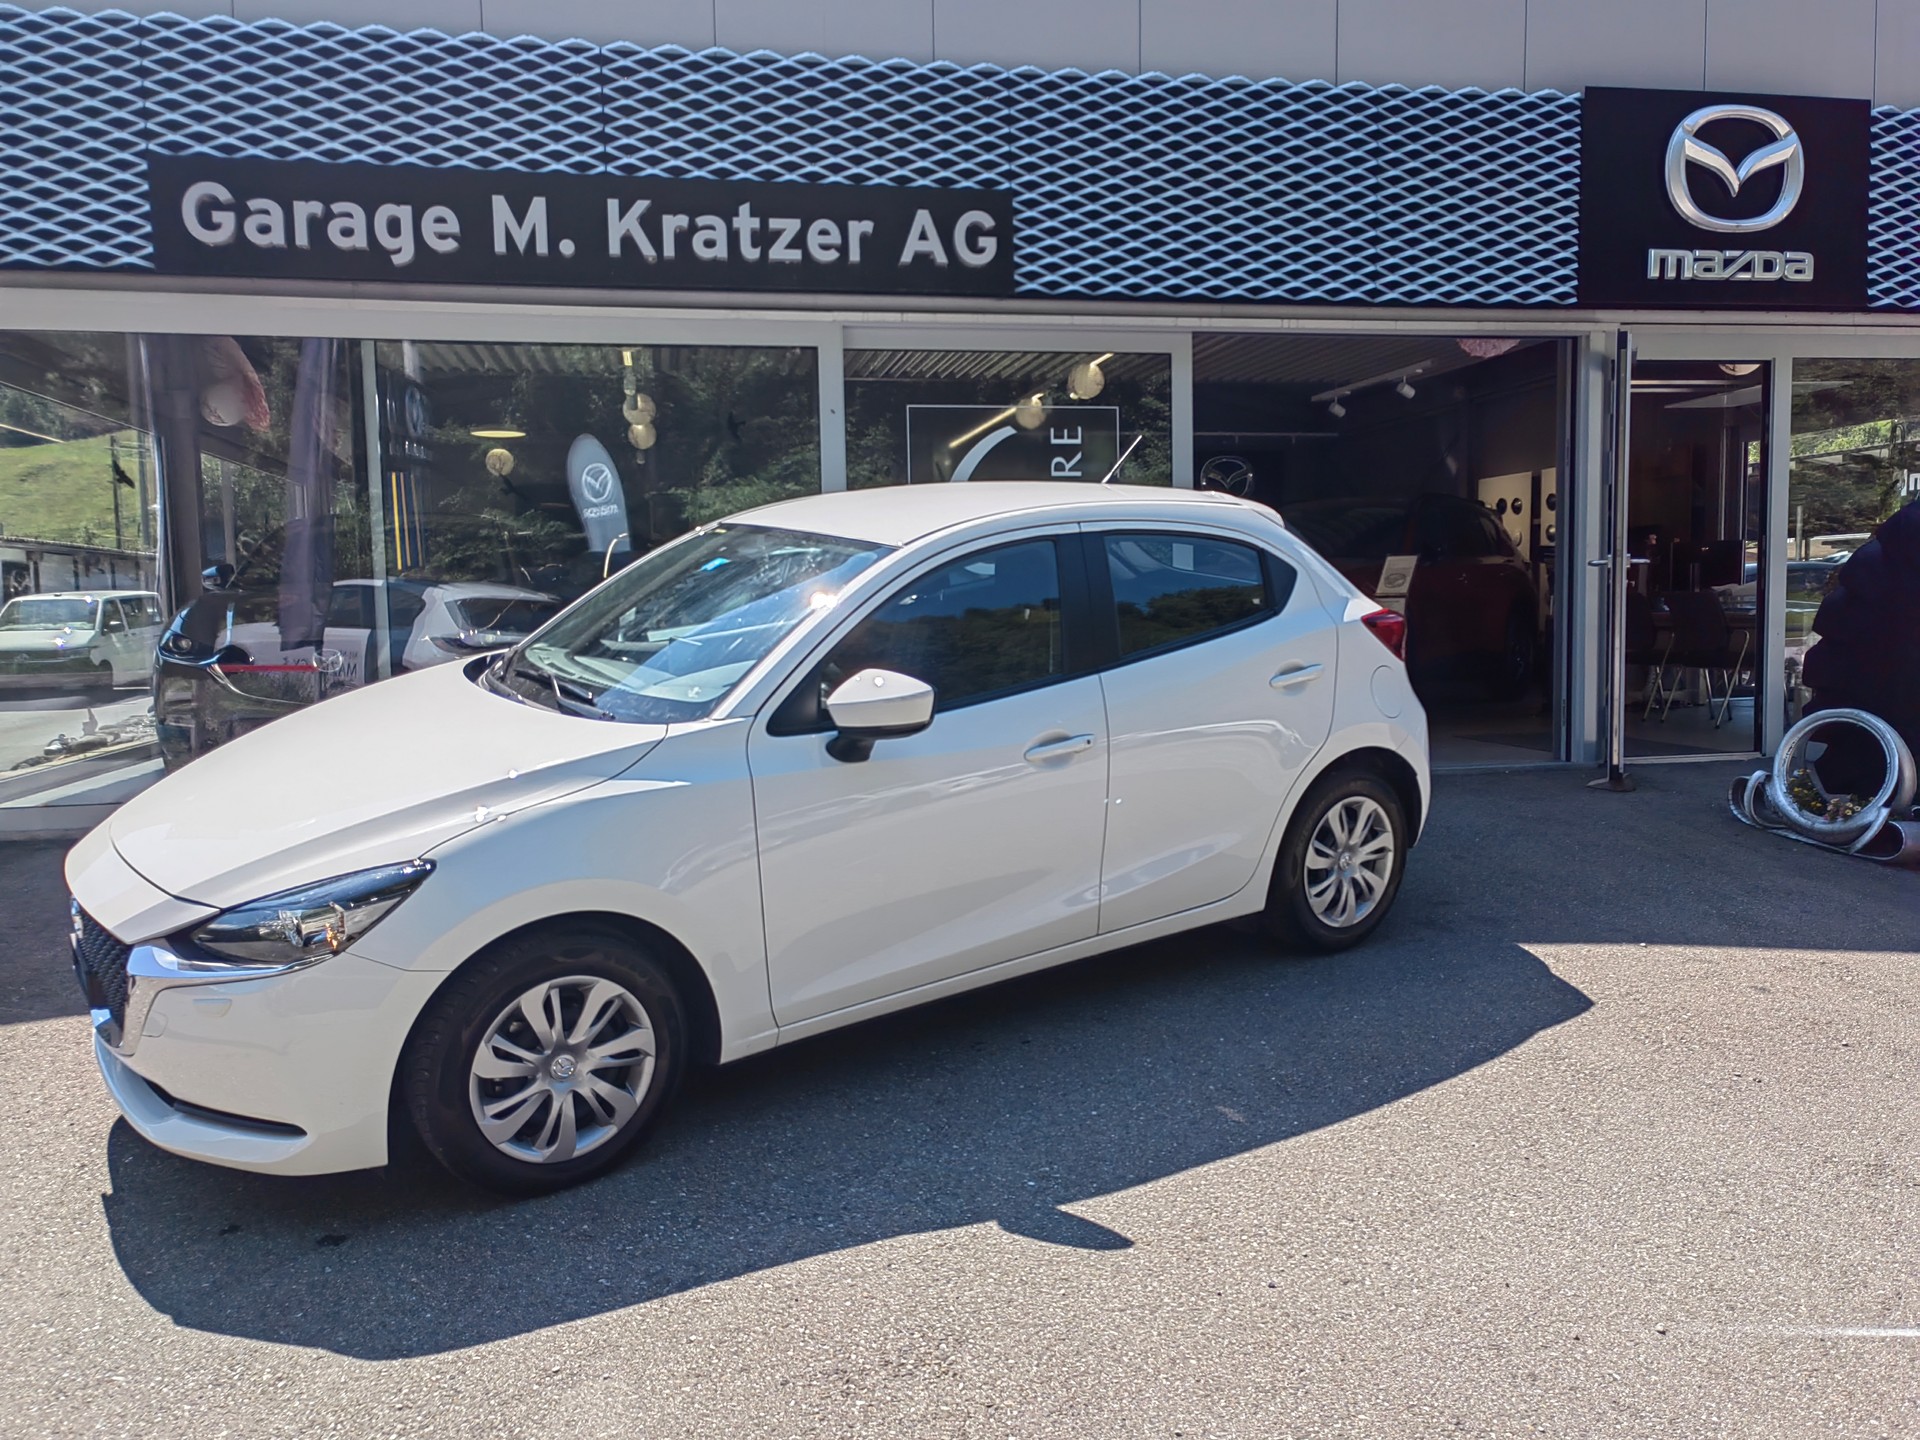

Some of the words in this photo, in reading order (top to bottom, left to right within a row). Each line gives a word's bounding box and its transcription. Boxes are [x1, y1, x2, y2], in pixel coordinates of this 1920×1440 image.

[181, 181, 461, 267] Garage
[491, 194, 576, 258] M.
[606, 198, 875, 264] Kratzer
[898, 208, 998, 267] AG
[1647, 248, 1815, 282] mazda
